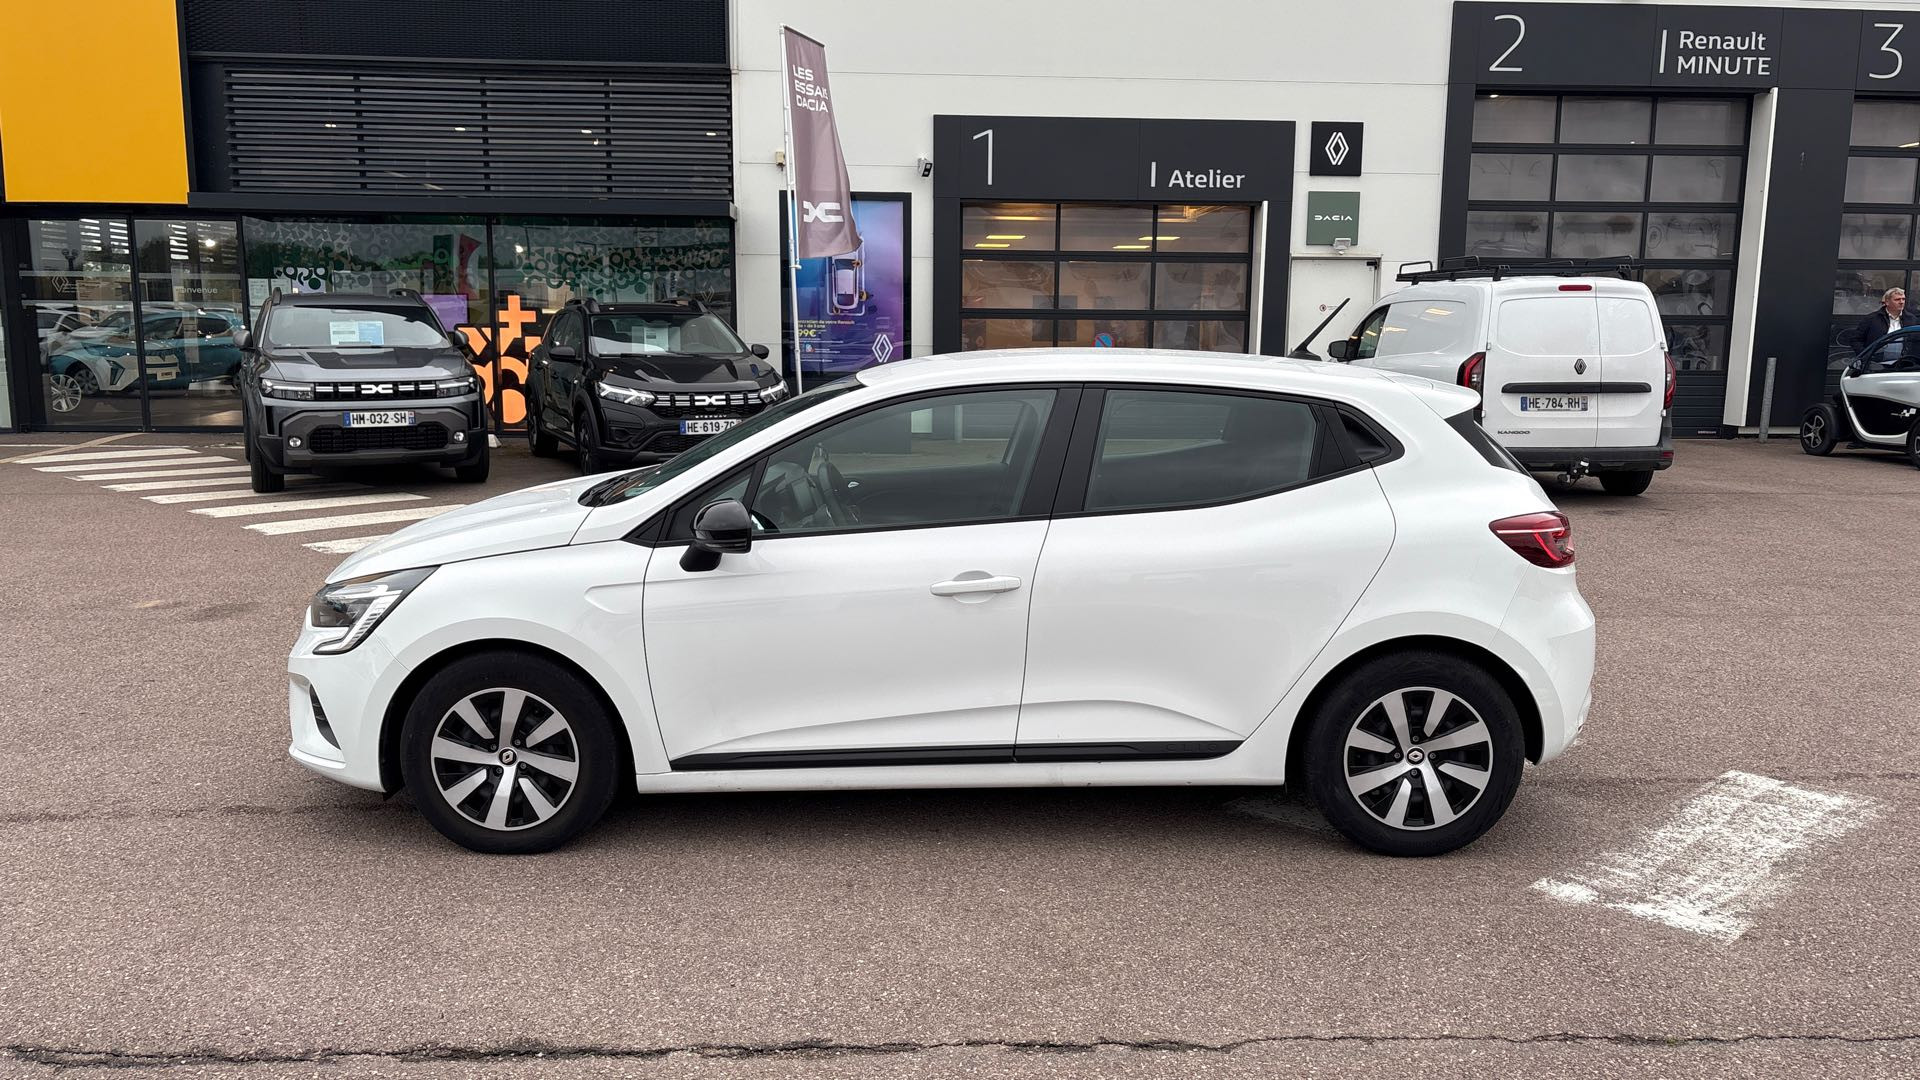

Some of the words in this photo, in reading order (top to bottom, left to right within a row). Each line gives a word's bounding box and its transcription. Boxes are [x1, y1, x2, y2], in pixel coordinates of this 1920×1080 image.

[1488, 14, 1526, 73] 2
[1678, 29, 1767, 52] Renault
[1868, 22, 1904, 80] 3
[792, 64, 814, 81] LES
[1676, 55, 1771, 76] MINUTE
[796, 94, 829, 112] DACIA
[972, 128, 993, 186] 1
[1168, 168, 1246, 189] Atelier
[1528, 397, 1580, 409] HE-784-RH
[351, 412, 407, 425] HM-032-SH
